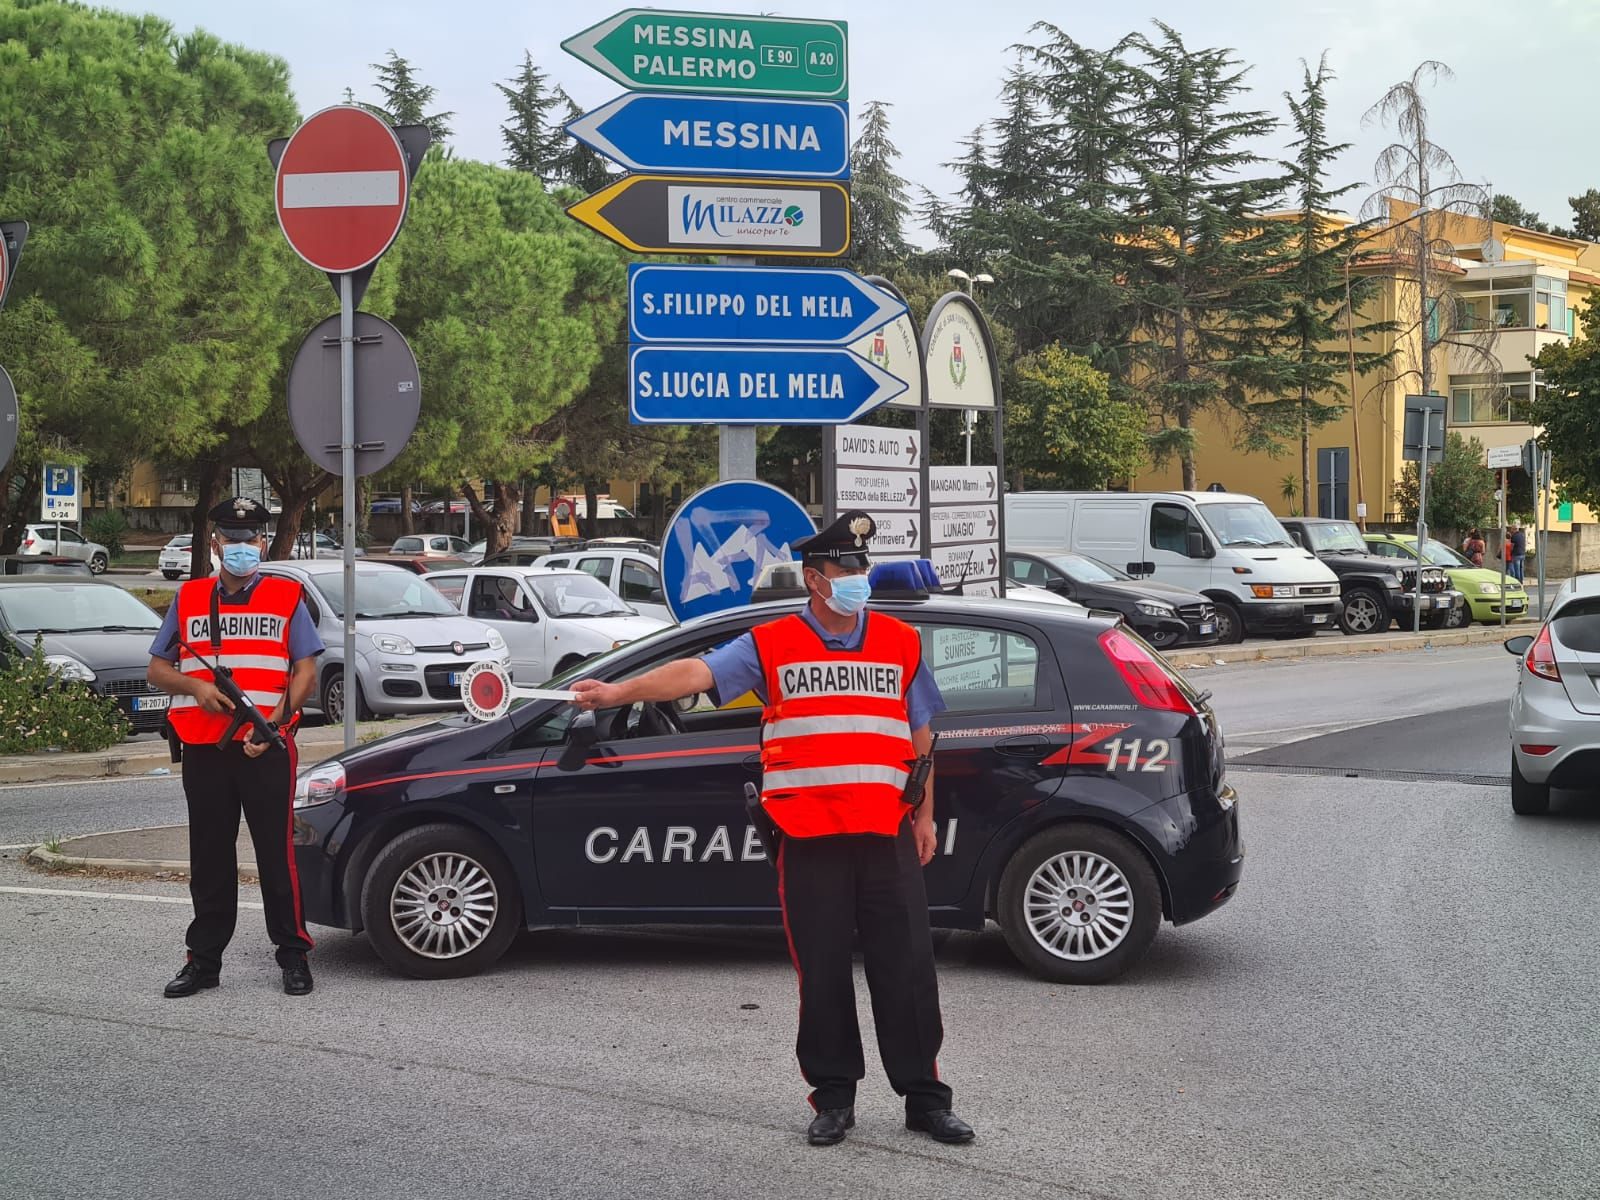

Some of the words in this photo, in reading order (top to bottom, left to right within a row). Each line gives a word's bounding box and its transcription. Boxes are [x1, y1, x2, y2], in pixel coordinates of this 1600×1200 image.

[634, 24, 755, 49] MESSINA
[634, 54, 756, 80] PALERMO
[767, 49, 775, 63] E
[777, 50, 793, 64] 90
[663, 119, 821, 151] MESSINA
[716, 195, 738, 204] centro
[739, 196, 783, 205] commerciale
[763, 227, 778, 237] per
[756, 294, 792, 317] DEL
[802, 296, 853, 318] MELA
[739, 373, 779, 398] DEL
[788, 373, 844, 399] MELA
[878, 439, 900, 456] AUTO
[52, 468, 69, 492] P
[854, 476, 890, 488] PROFUMERIA
[930, 479, 961, 492] MANGANO
[880, 491, 907, 502] BELLEZZA
[191, 615, 282, 638] CAABINIERI
[944, 640, 976, 660] SUNRISE
[784, 666, 900, 694] CARABINIERI
[1104, 737, 1170, 773] 112
